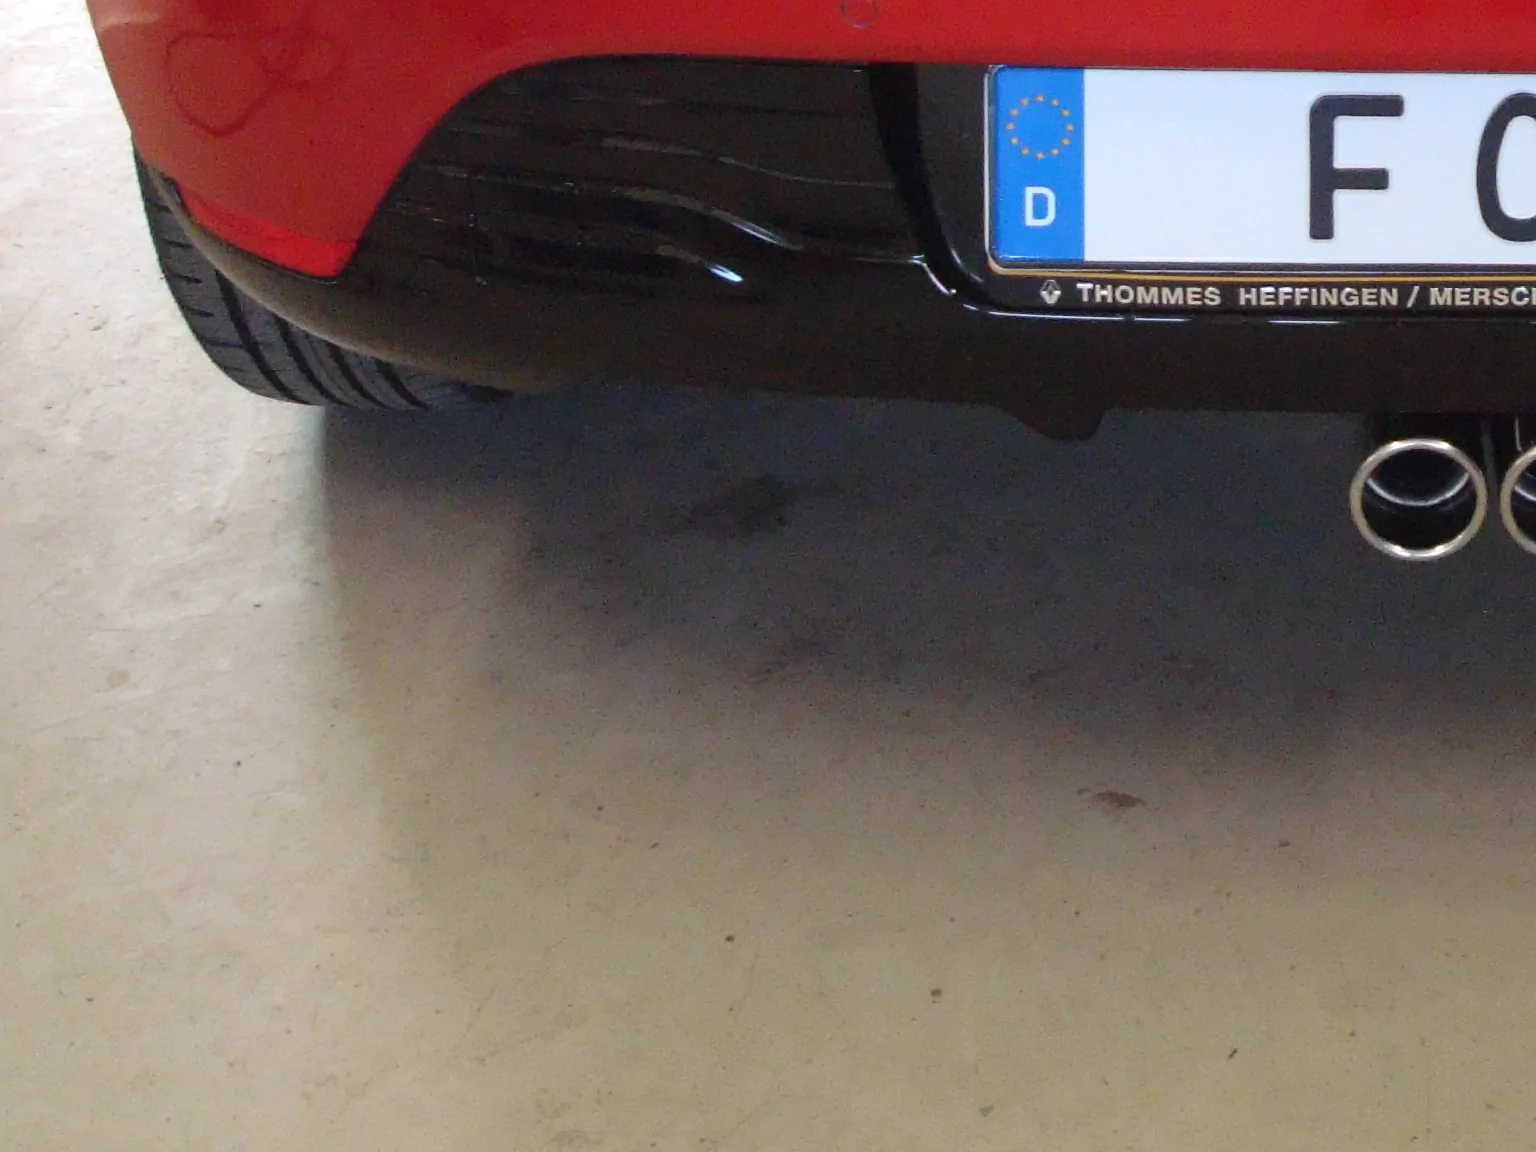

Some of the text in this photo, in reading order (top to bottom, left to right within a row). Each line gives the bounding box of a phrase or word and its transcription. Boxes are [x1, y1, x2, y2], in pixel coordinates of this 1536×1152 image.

[1024, 186, 1056, 228] D
[1076, 282, 1222, 306] THOMMES
[1238, 286, 1399, 307] HEFFINGEN
